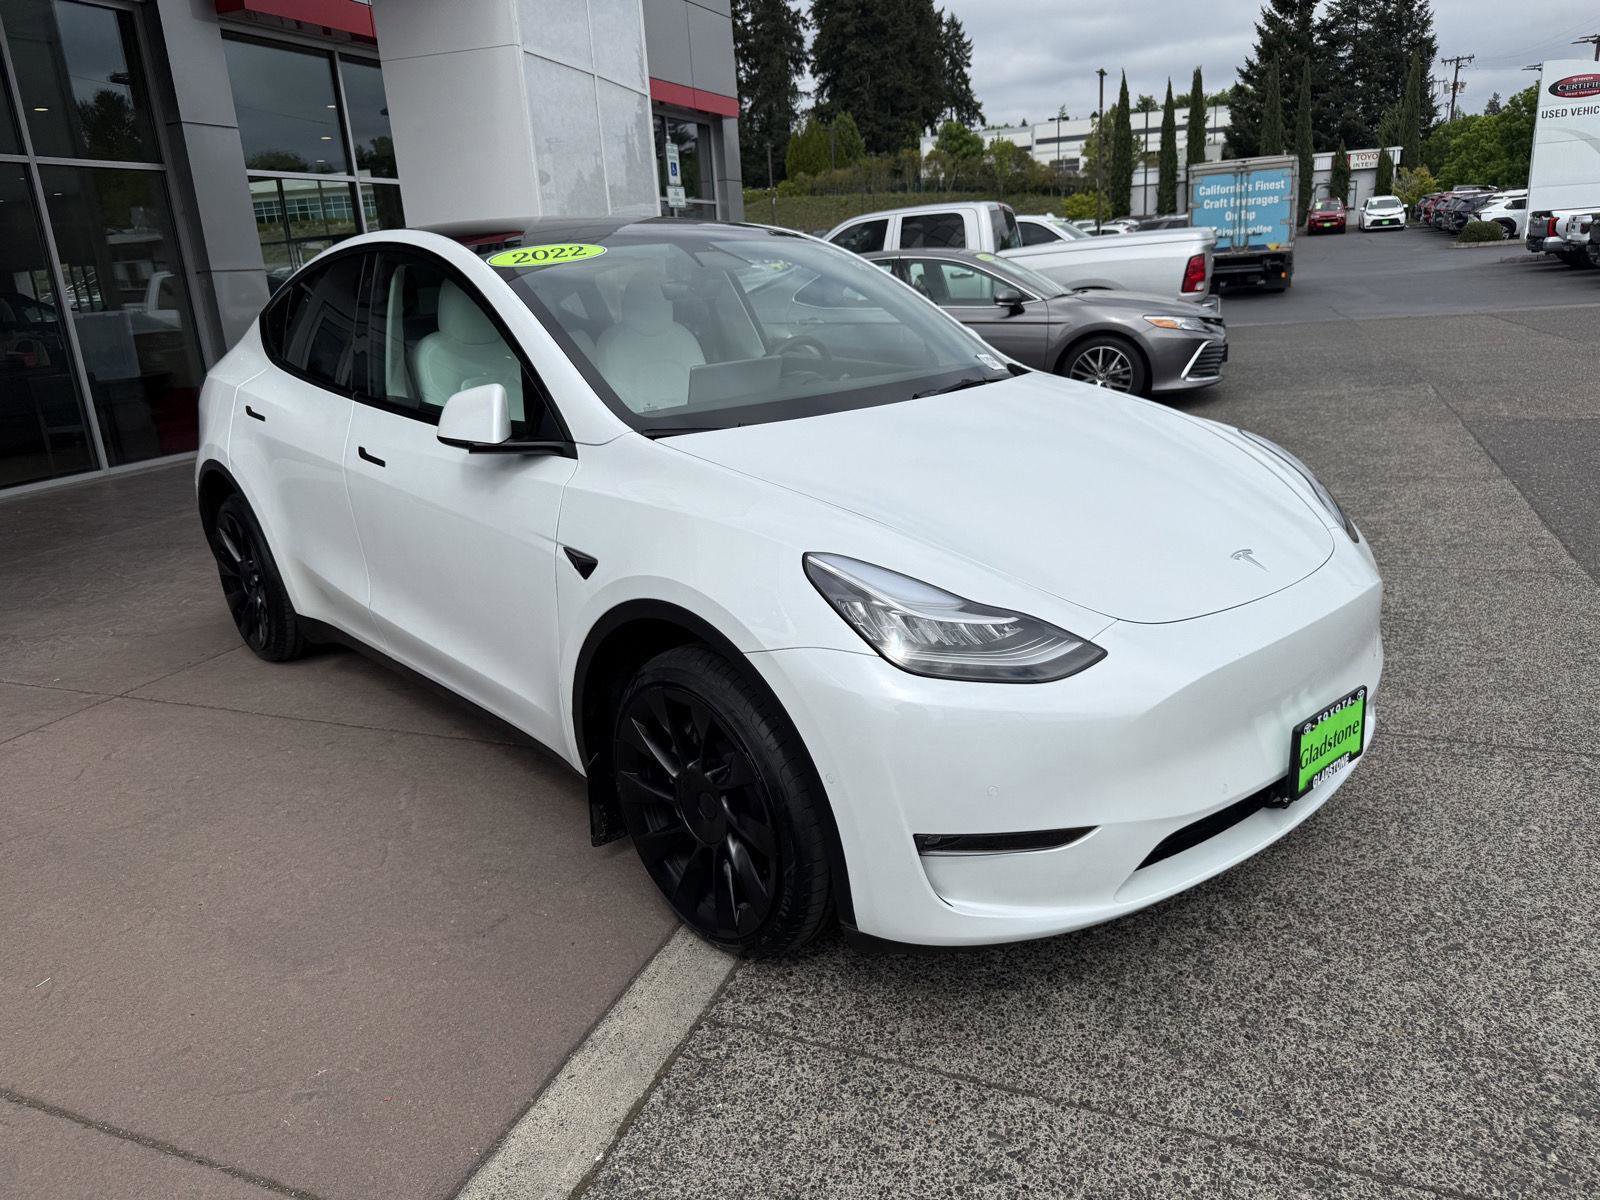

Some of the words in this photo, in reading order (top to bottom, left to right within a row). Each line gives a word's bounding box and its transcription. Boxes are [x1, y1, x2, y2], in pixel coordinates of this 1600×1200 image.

[1541, 108, 1568, 119] USED
[1356, 153, 1379, 161] TOYO
[1199, 182, 1253, 196] California's
[1255, 179, 1286, 192] Finest
[1203, 199, 1228, 209] Craft
[1230, 195, 1279, 207] Beverages
[512, 245, 587, 264] 2022
[1317, 696, 1352, 724] TOYOTA
[1300, 720, 1360, 770] Gladstone
[1312, 752, 1350, 789] GLADSTONE
